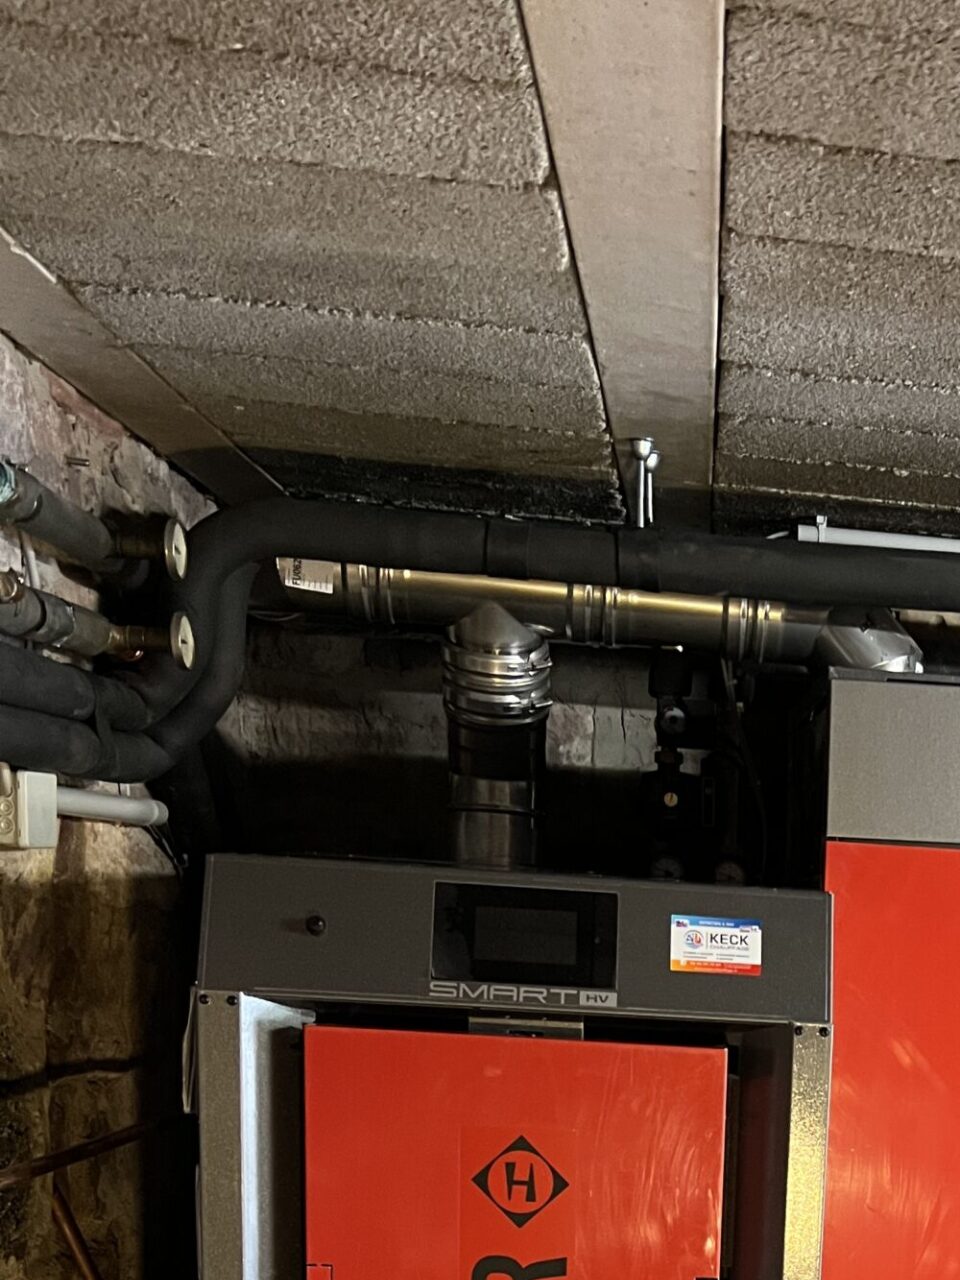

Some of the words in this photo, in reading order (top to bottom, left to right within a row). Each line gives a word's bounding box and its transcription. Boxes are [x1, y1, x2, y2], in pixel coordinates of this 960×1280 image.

[709, 933, 749, 946] KECK
[429, 981, 578, 1005] SMART
[586, 993, 609, 1004] HV
